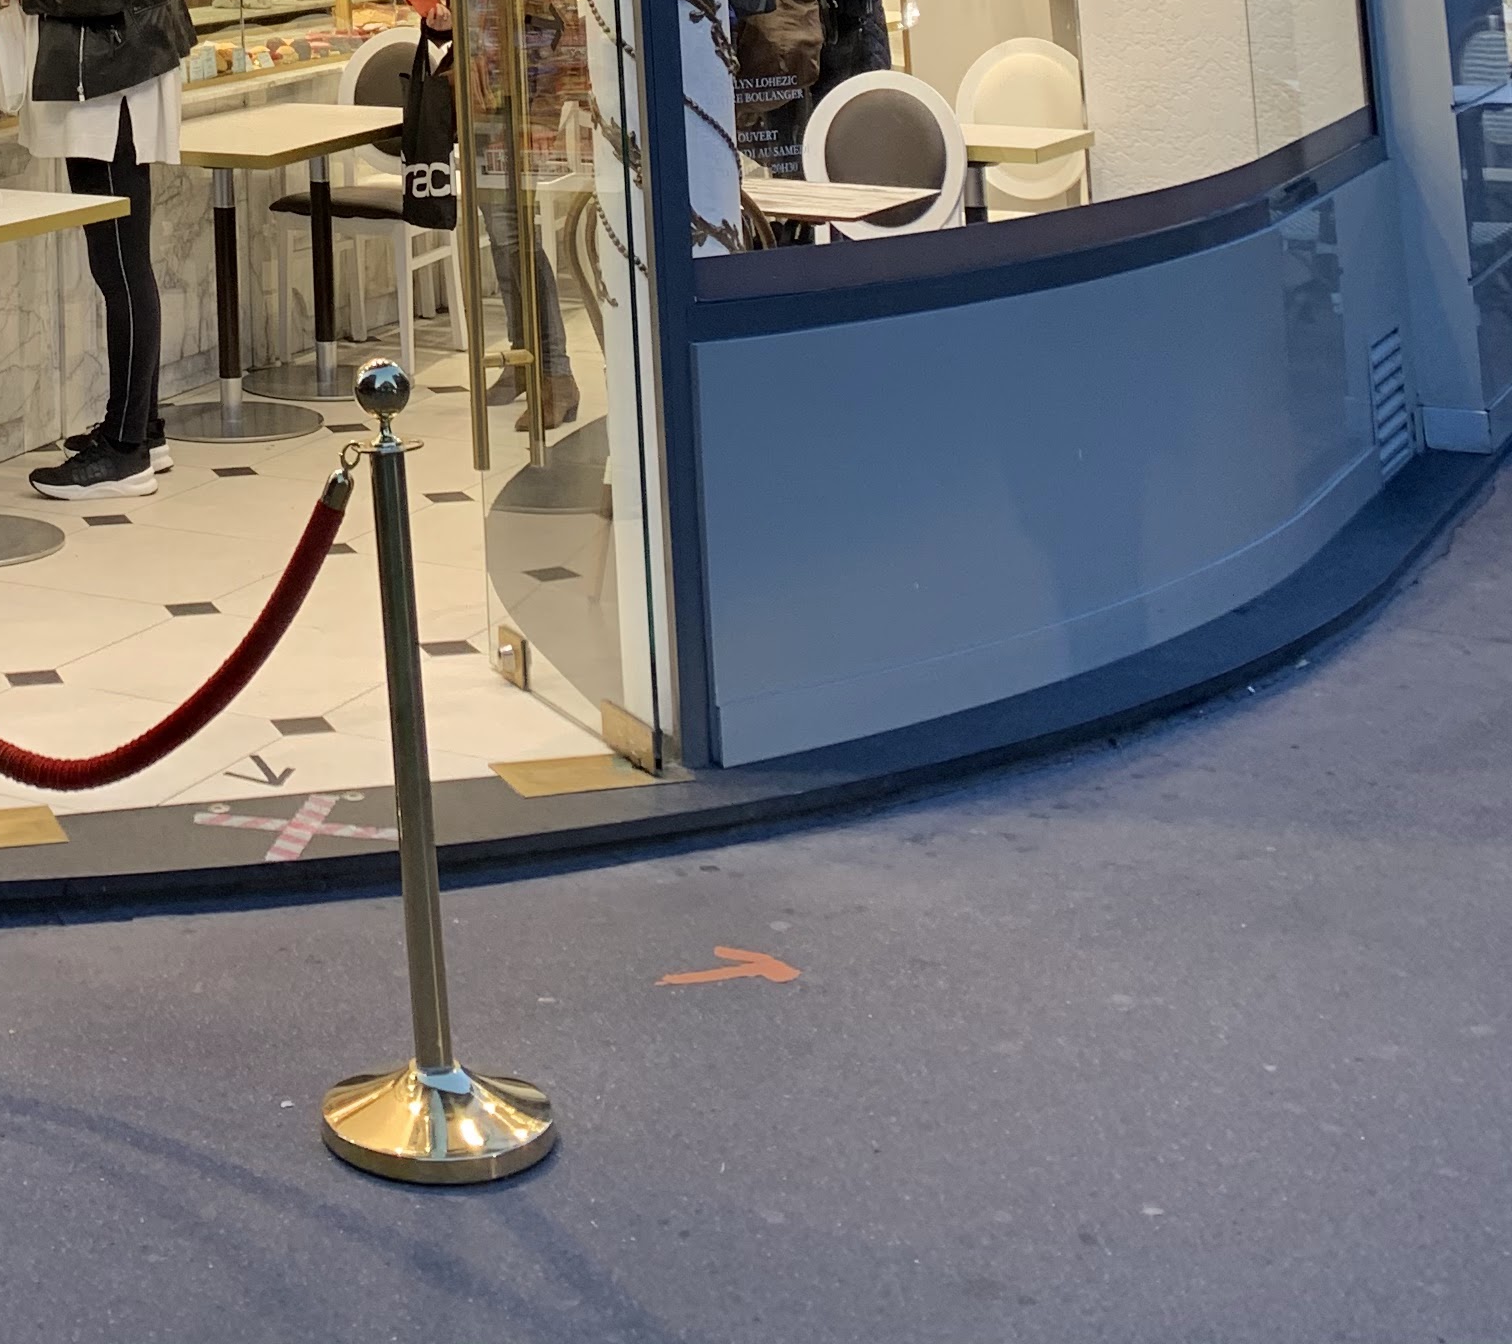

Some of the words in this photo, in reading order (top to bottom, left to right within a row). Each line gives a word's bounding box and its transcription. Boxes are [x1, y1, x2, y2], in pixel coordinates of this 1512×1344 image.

[755, 74, 798, 88] LOHEZIC
[745, 88, 804, 103] BOULANGER
[737, 129, 779, 143] OUVERT
[757, 146, 770, 158] AU
